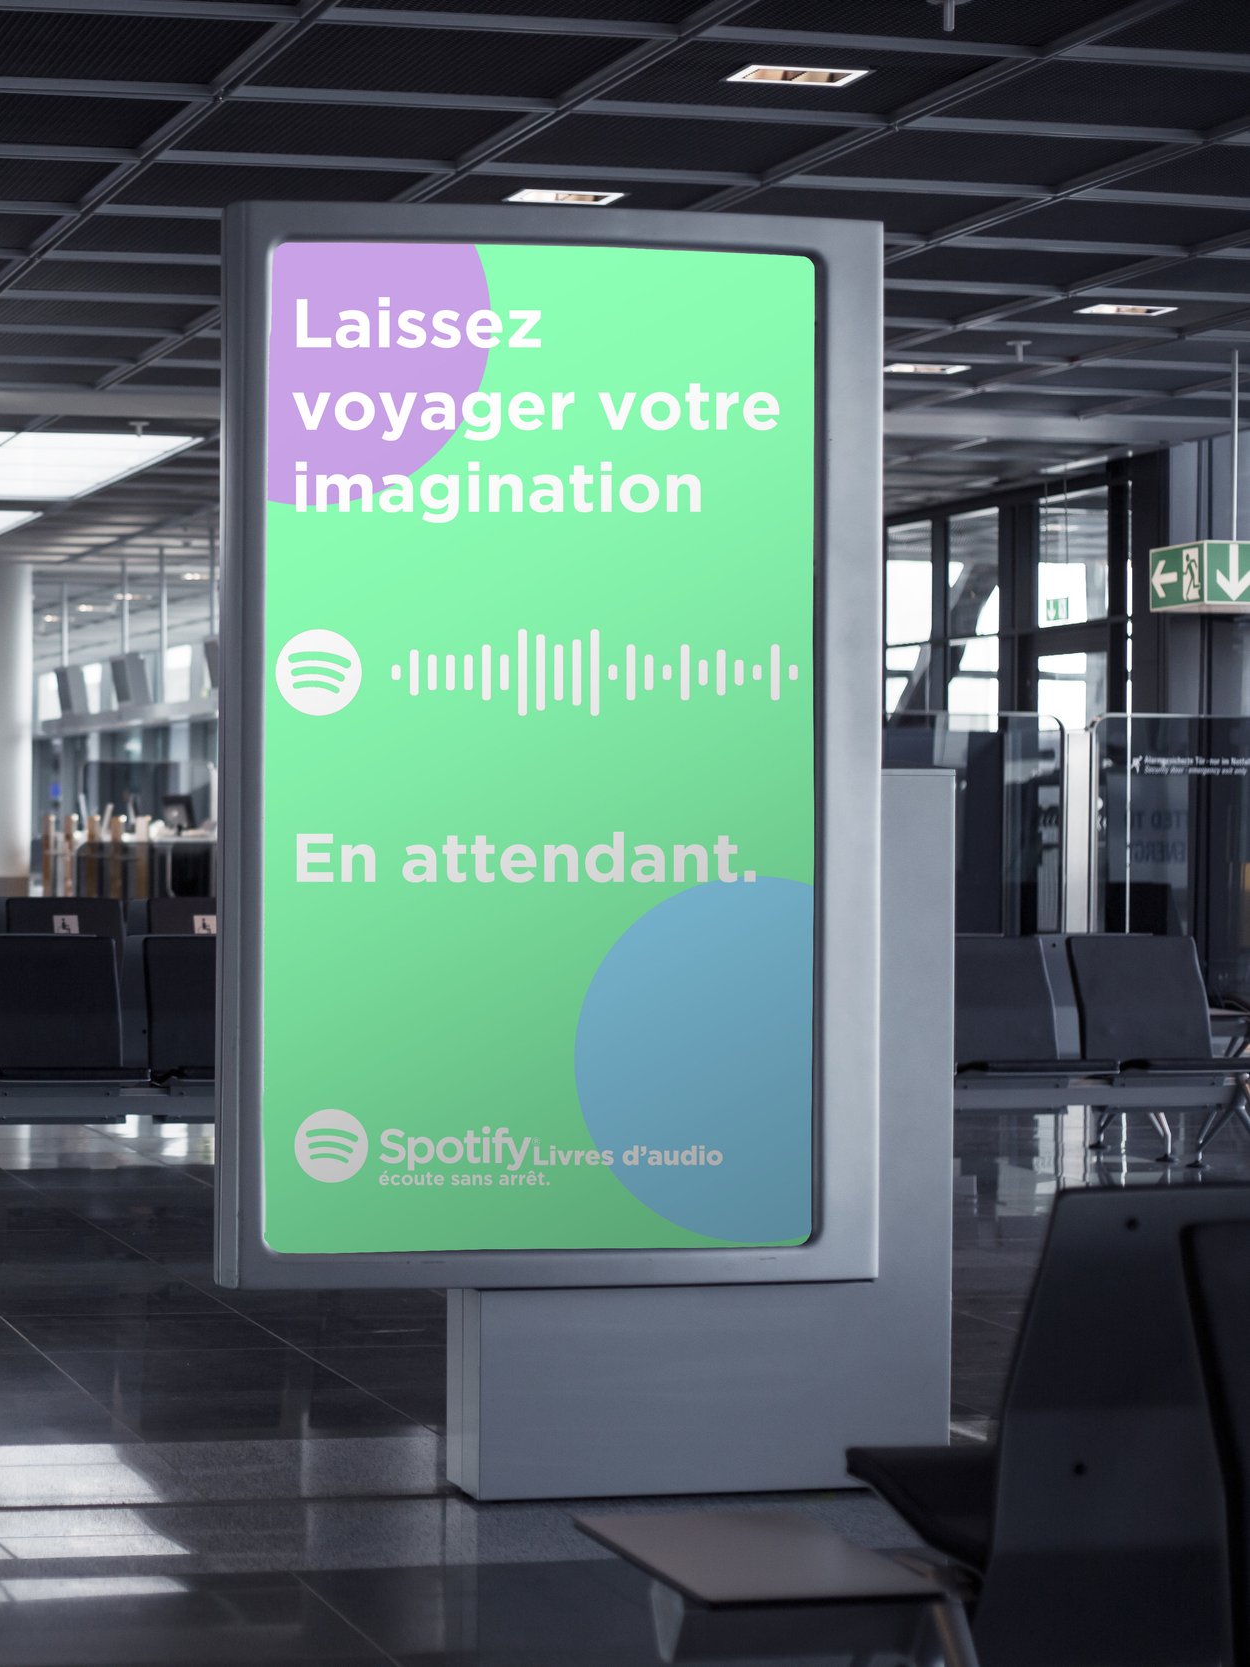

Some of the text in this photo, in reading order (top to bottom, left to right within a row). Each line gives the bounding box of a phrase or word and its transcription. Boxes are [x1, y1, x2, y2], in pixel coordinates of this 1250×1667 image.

[296, 296, 542, 349] Laissez
[292, 382, 780, 442] voyager votre
[295, 461, 702, 524] imagination
[296, 831, 757, 883] En attendant.
[378, 1170, 551, 1186] écoute sans arrêt.
[533, 1145, 615, 1166] Livres
[622, 1145, 723, 1166] d’audio
